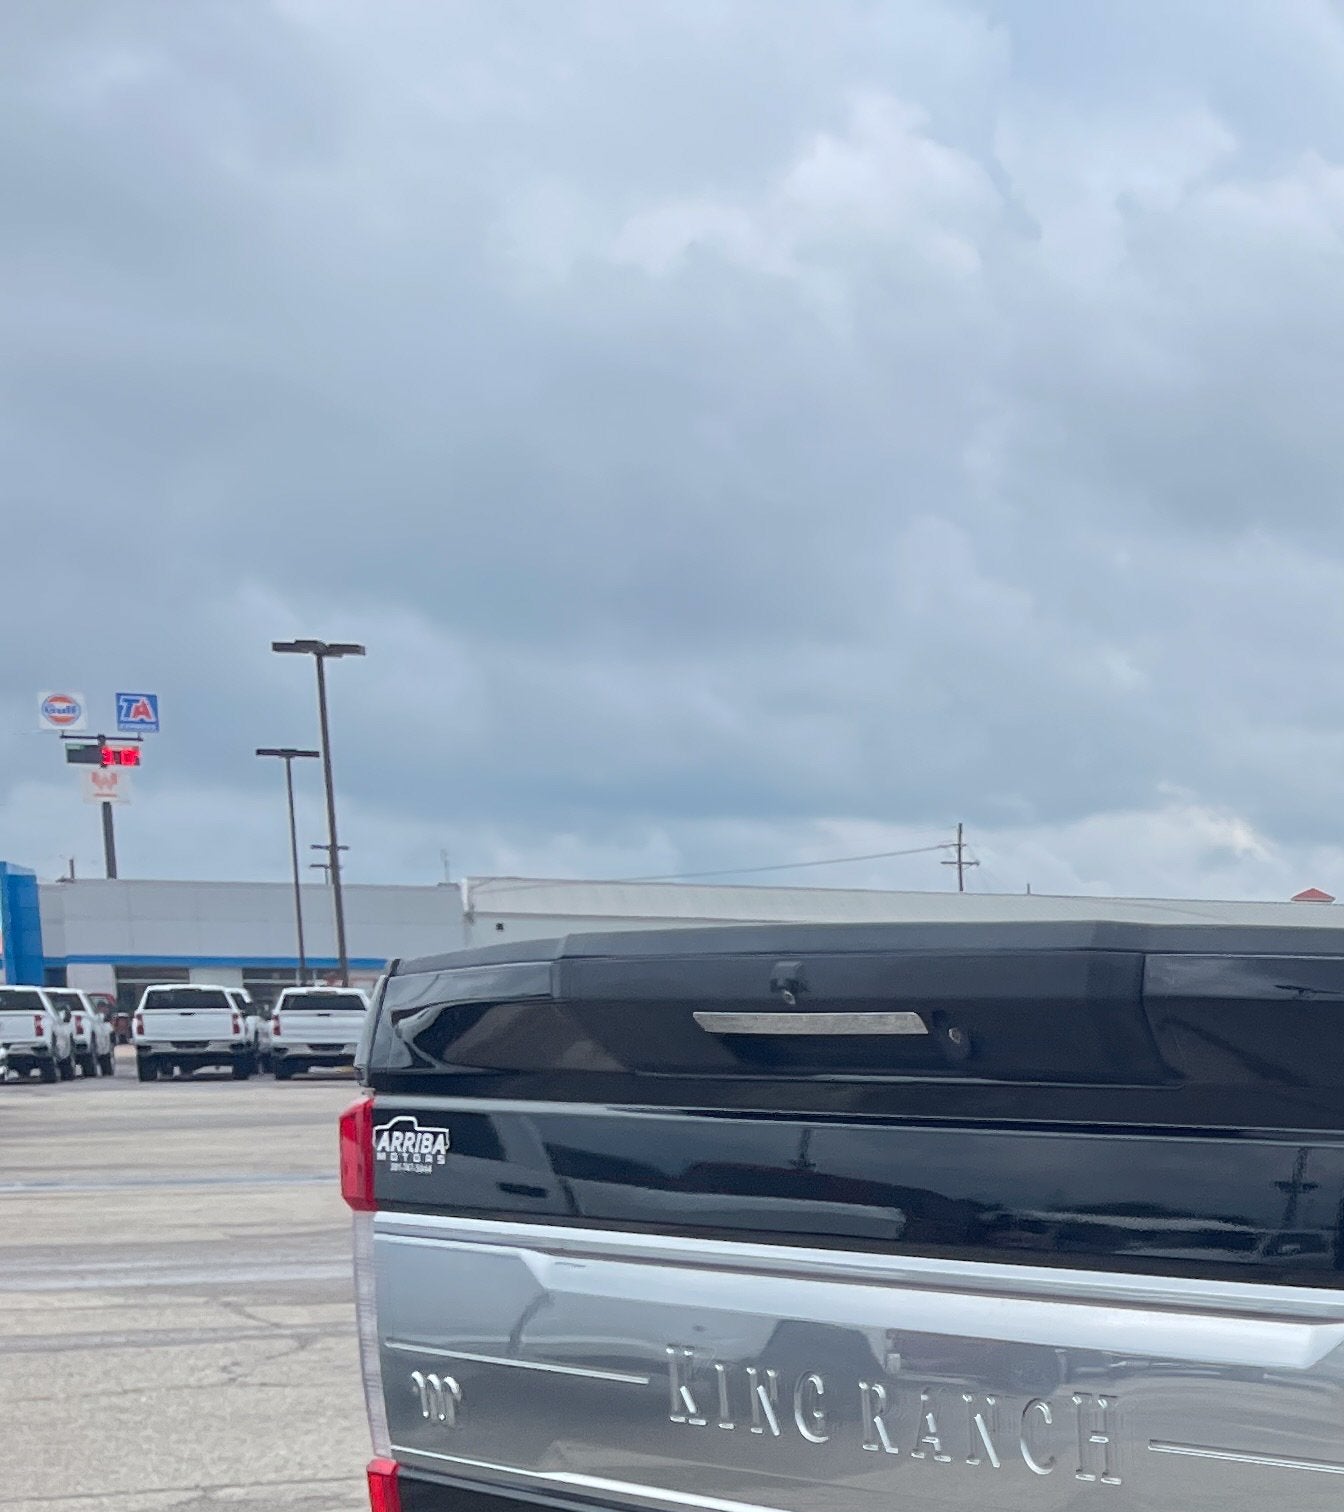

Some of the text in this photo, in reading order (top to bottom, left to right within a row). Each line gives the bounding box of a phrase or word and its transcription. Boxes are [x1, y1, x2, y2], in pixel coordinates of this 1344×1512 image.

[119, 695, 156, 722] TA
[376, 1130, 447, 1155] ARRIBA
[376, 1151, 446, 1165] MOTORS
[667, 1343, 1122, 1486] KING RANCH
